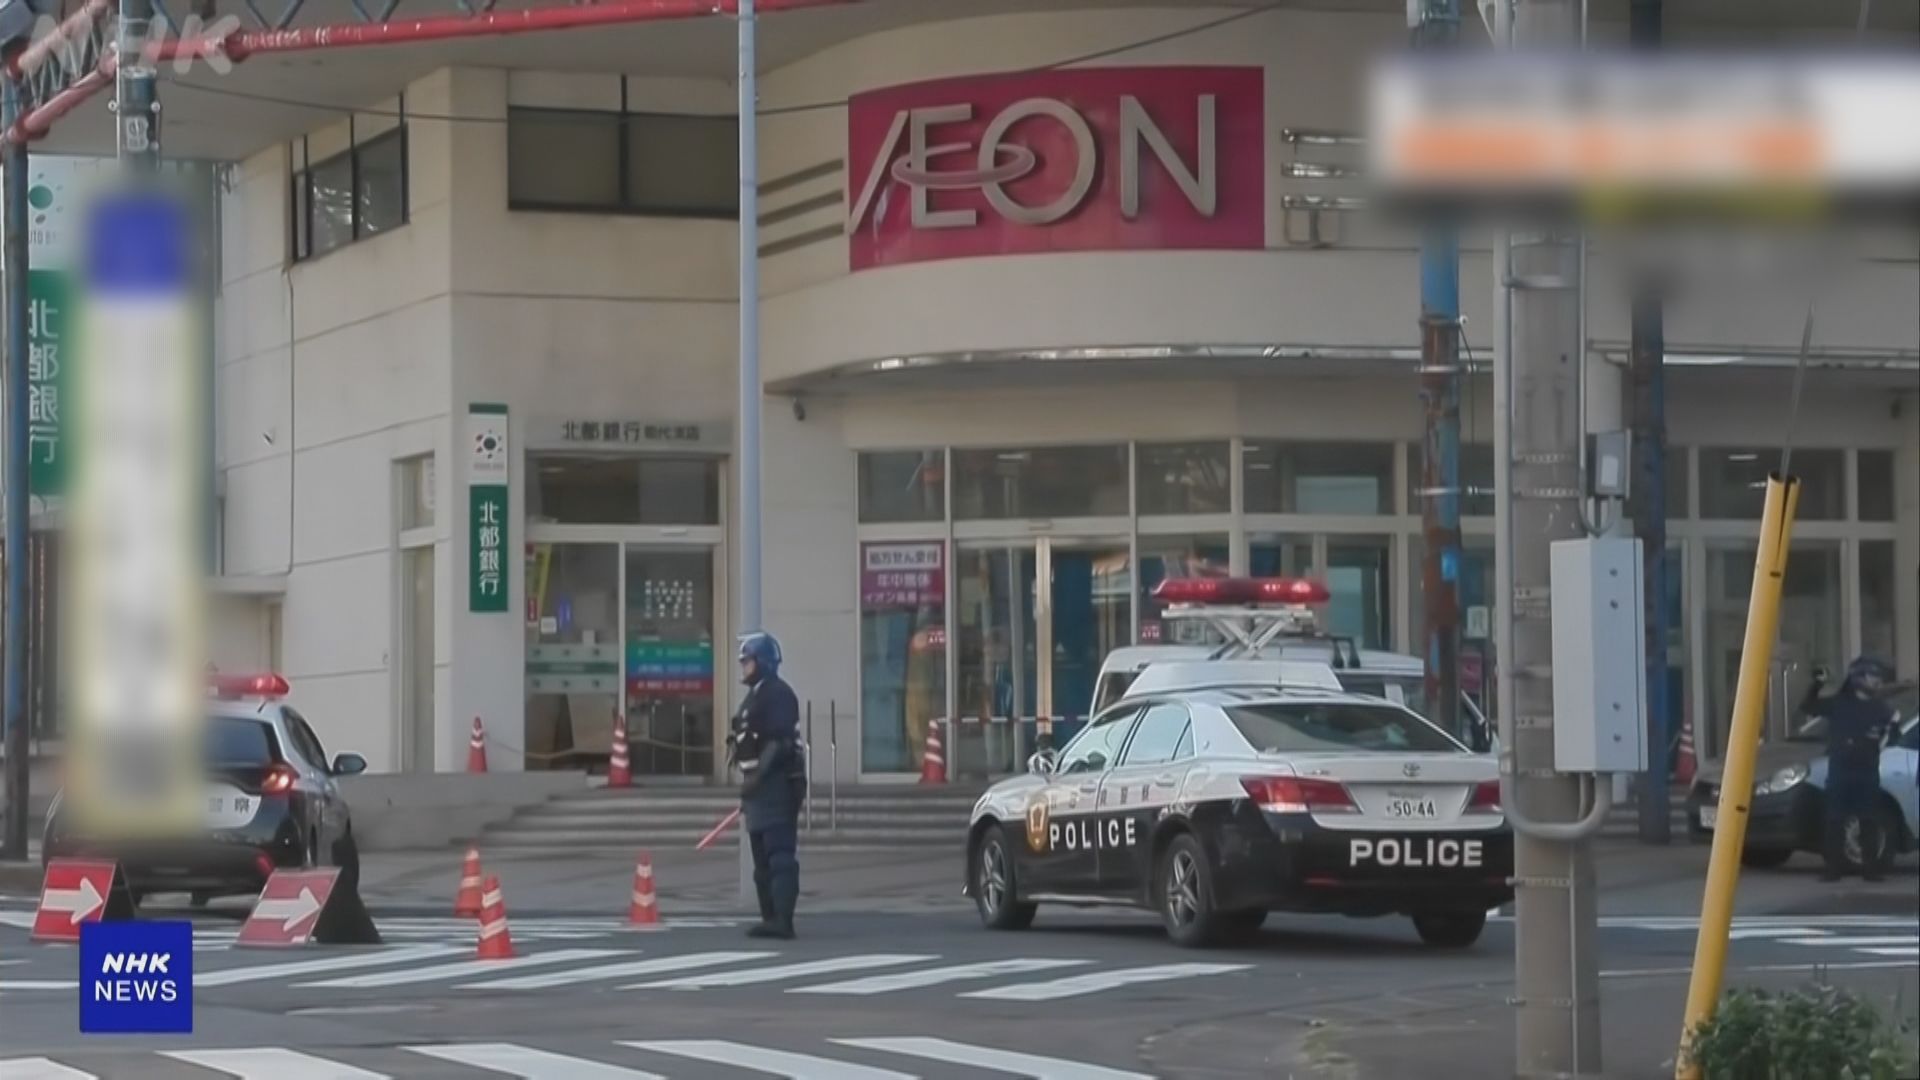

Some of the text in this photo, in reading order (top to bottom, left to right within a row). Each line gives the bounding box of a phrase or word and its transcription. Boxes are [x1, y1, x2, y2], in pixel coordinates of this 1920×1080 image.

[29, 299, 59, 465] 北都銀行
[562, 420, 640, 443] 北都銀行
[479, 500, 500, 596] 北都銀行
[1049, 817, 1136, 851] POLICE
[1350, 838, 1483, 867] POLICE
